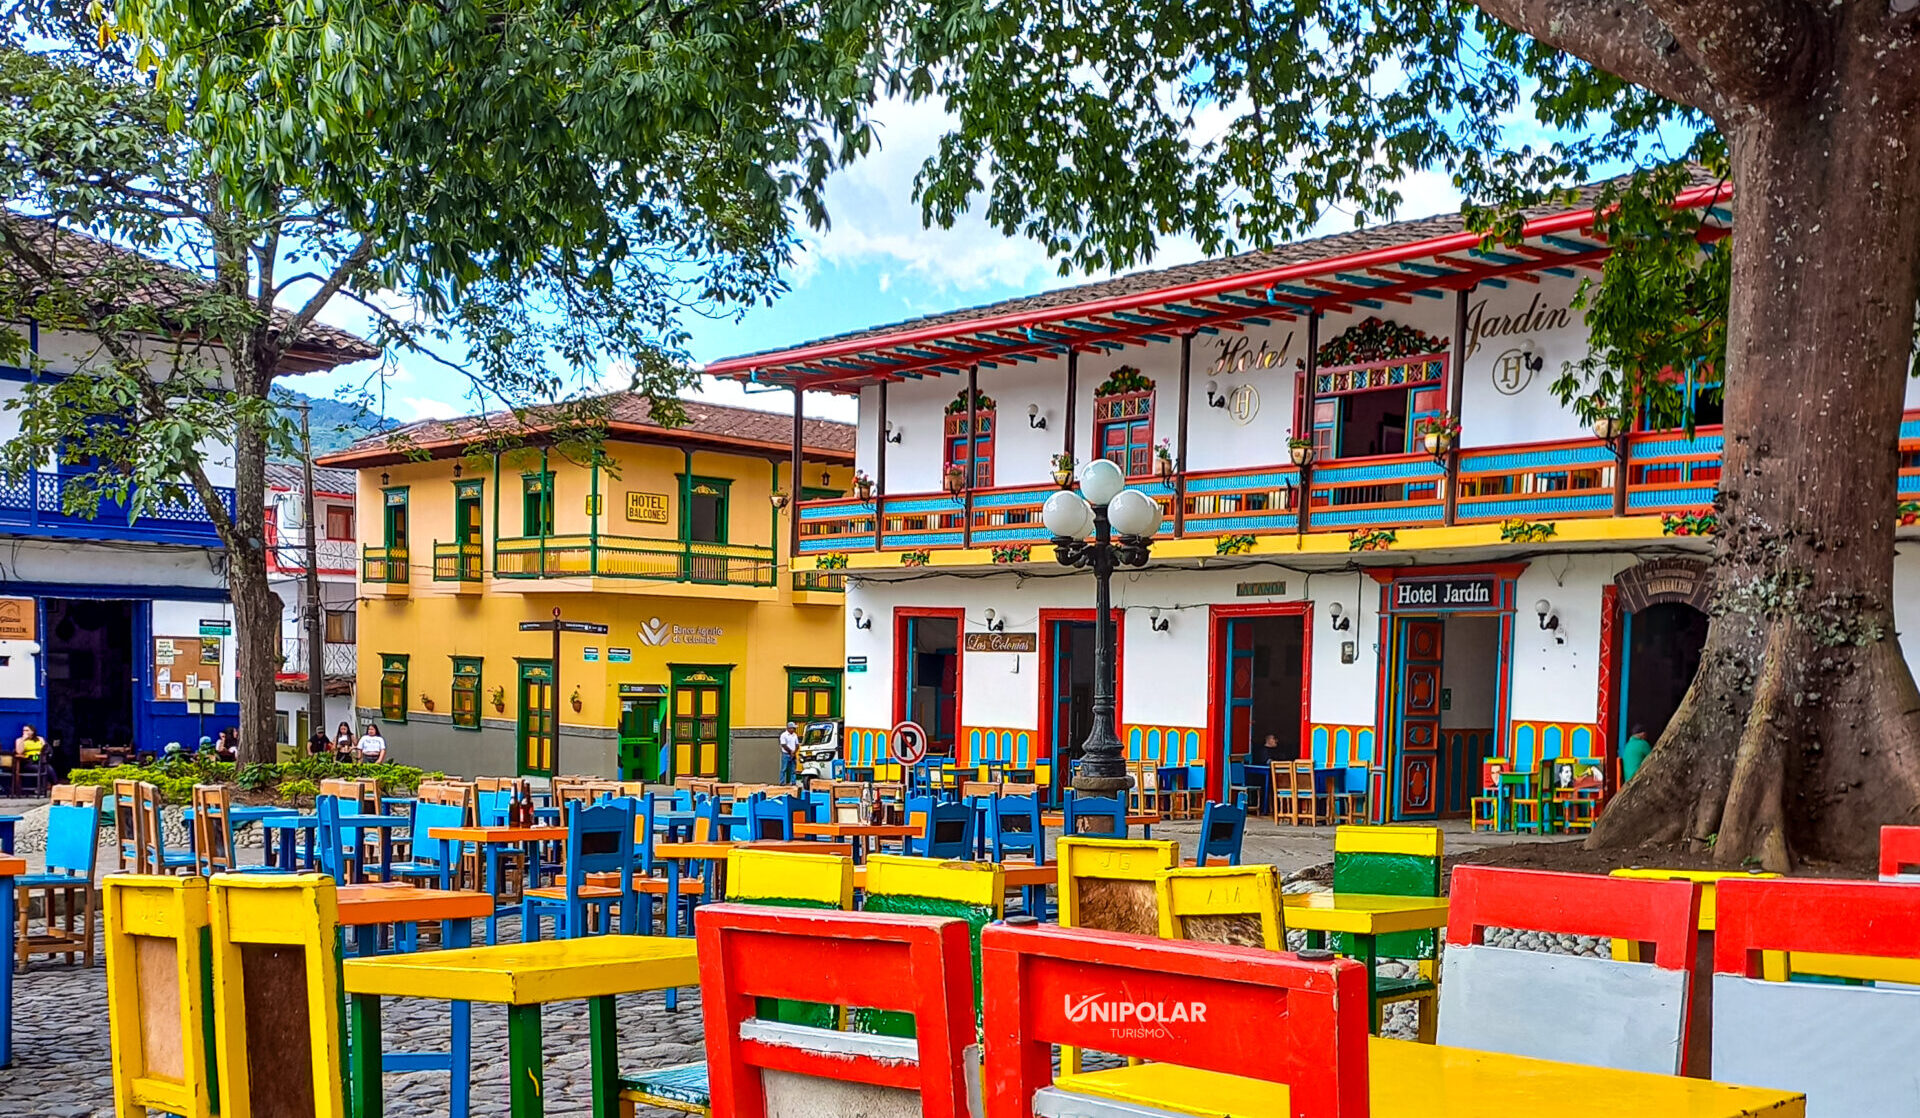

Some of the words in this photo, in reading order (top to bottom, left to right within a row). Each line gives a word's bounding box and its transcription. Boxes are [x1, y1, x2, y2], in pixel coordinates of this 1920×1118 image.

[1207, 331, 1294, 376] Hotel
[1464, 292, 1571, 362] Jardin
[631, 494, 665, 509] HOTEL
[629, 508, 666, 520] BALCONES
[1397, 584, 1437, 604] Hotel
[1444, 582, 1489, 603] Jardín
[673, 625, 695, 634] Banco
[673, 635, 681, 643] de
[684, 635, 717, 644] Colombia
[966, 634, 986, 650] Las
[901, 731, 917, 757] P
